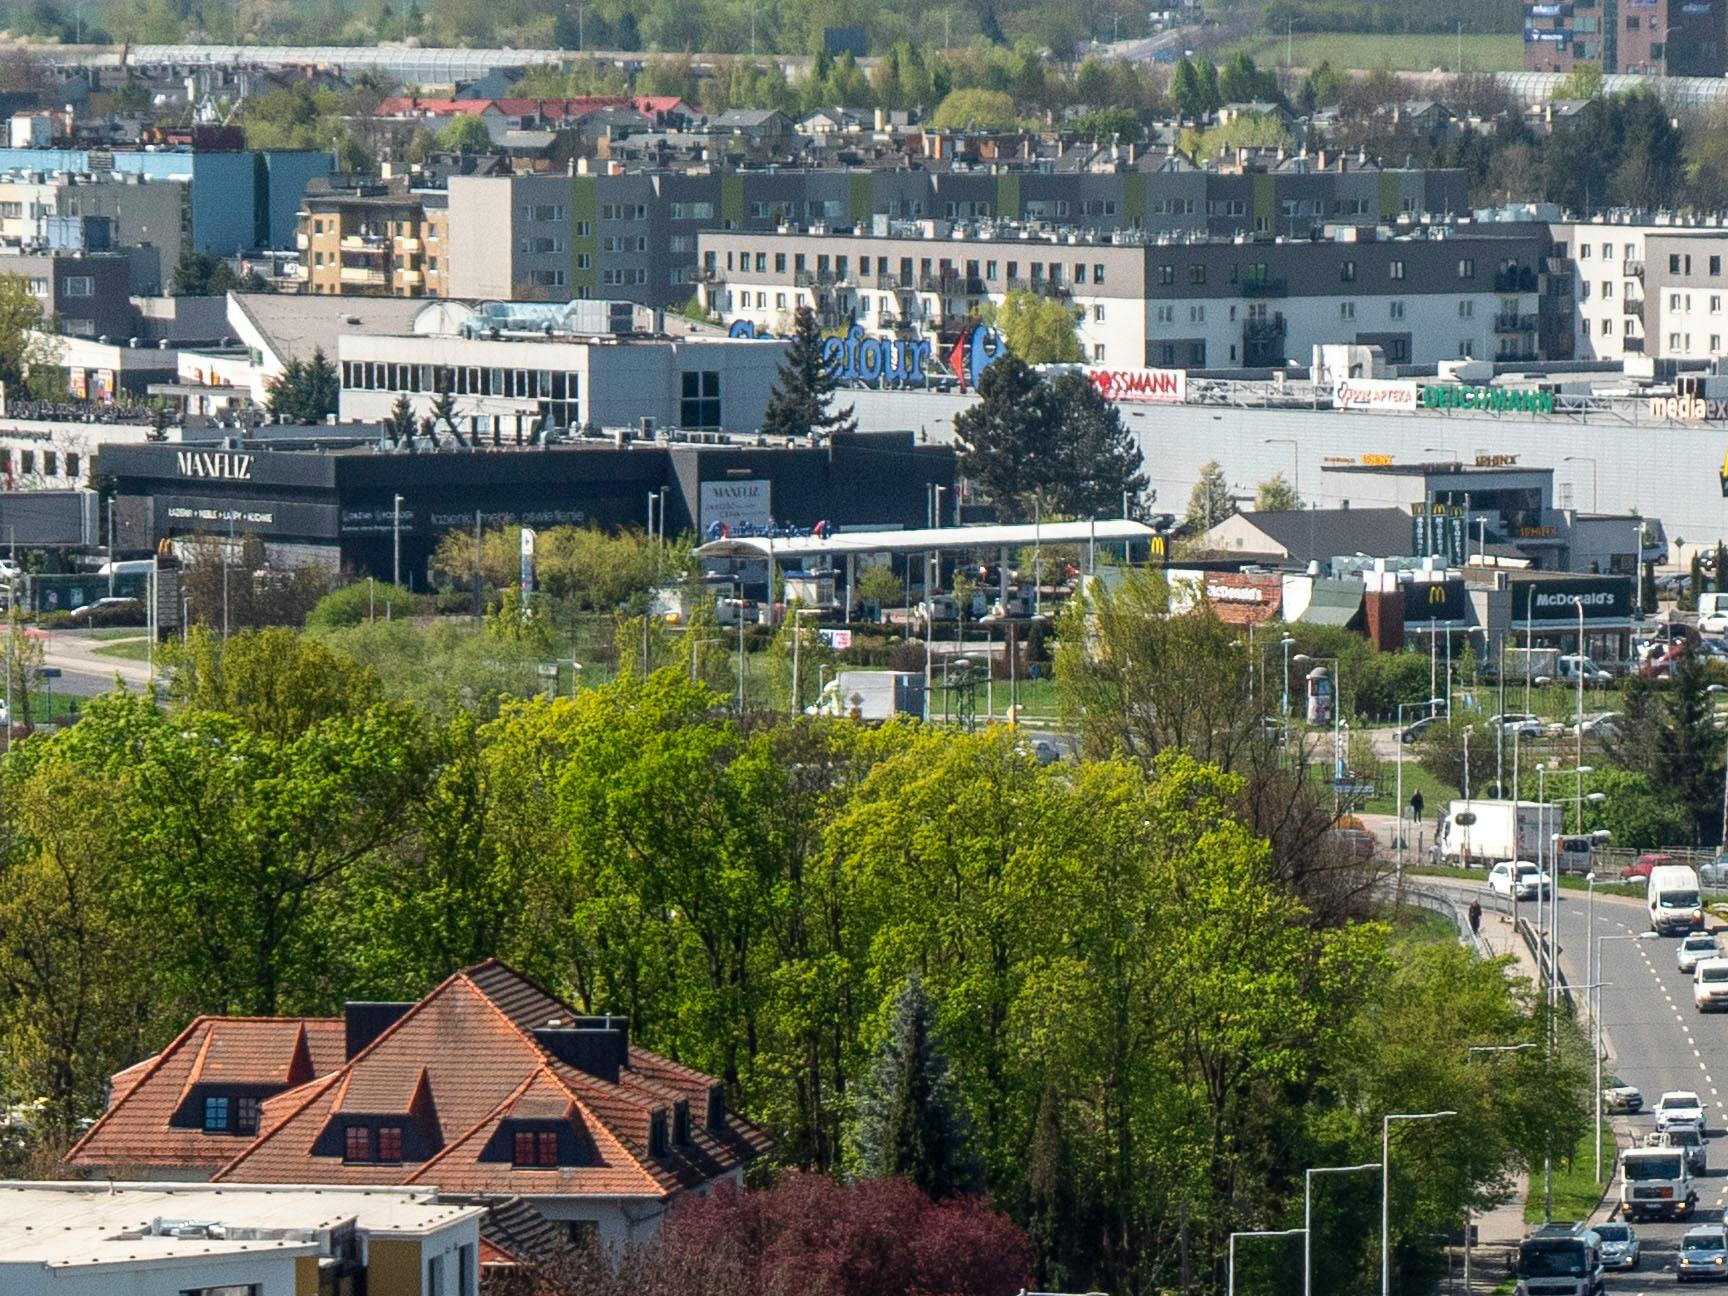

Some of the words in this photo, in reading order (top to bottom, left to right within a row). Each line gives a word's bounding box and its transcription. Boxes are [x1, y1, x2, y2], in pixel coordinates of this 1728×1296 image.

[1372, 389, 1412, 404] APTEKA
[1423, 384, 1554, 414] DEICHMANN
[176, 451, 251, 479] MAXFLIZ
[1535, 590, 1615, 609] McDonald's
